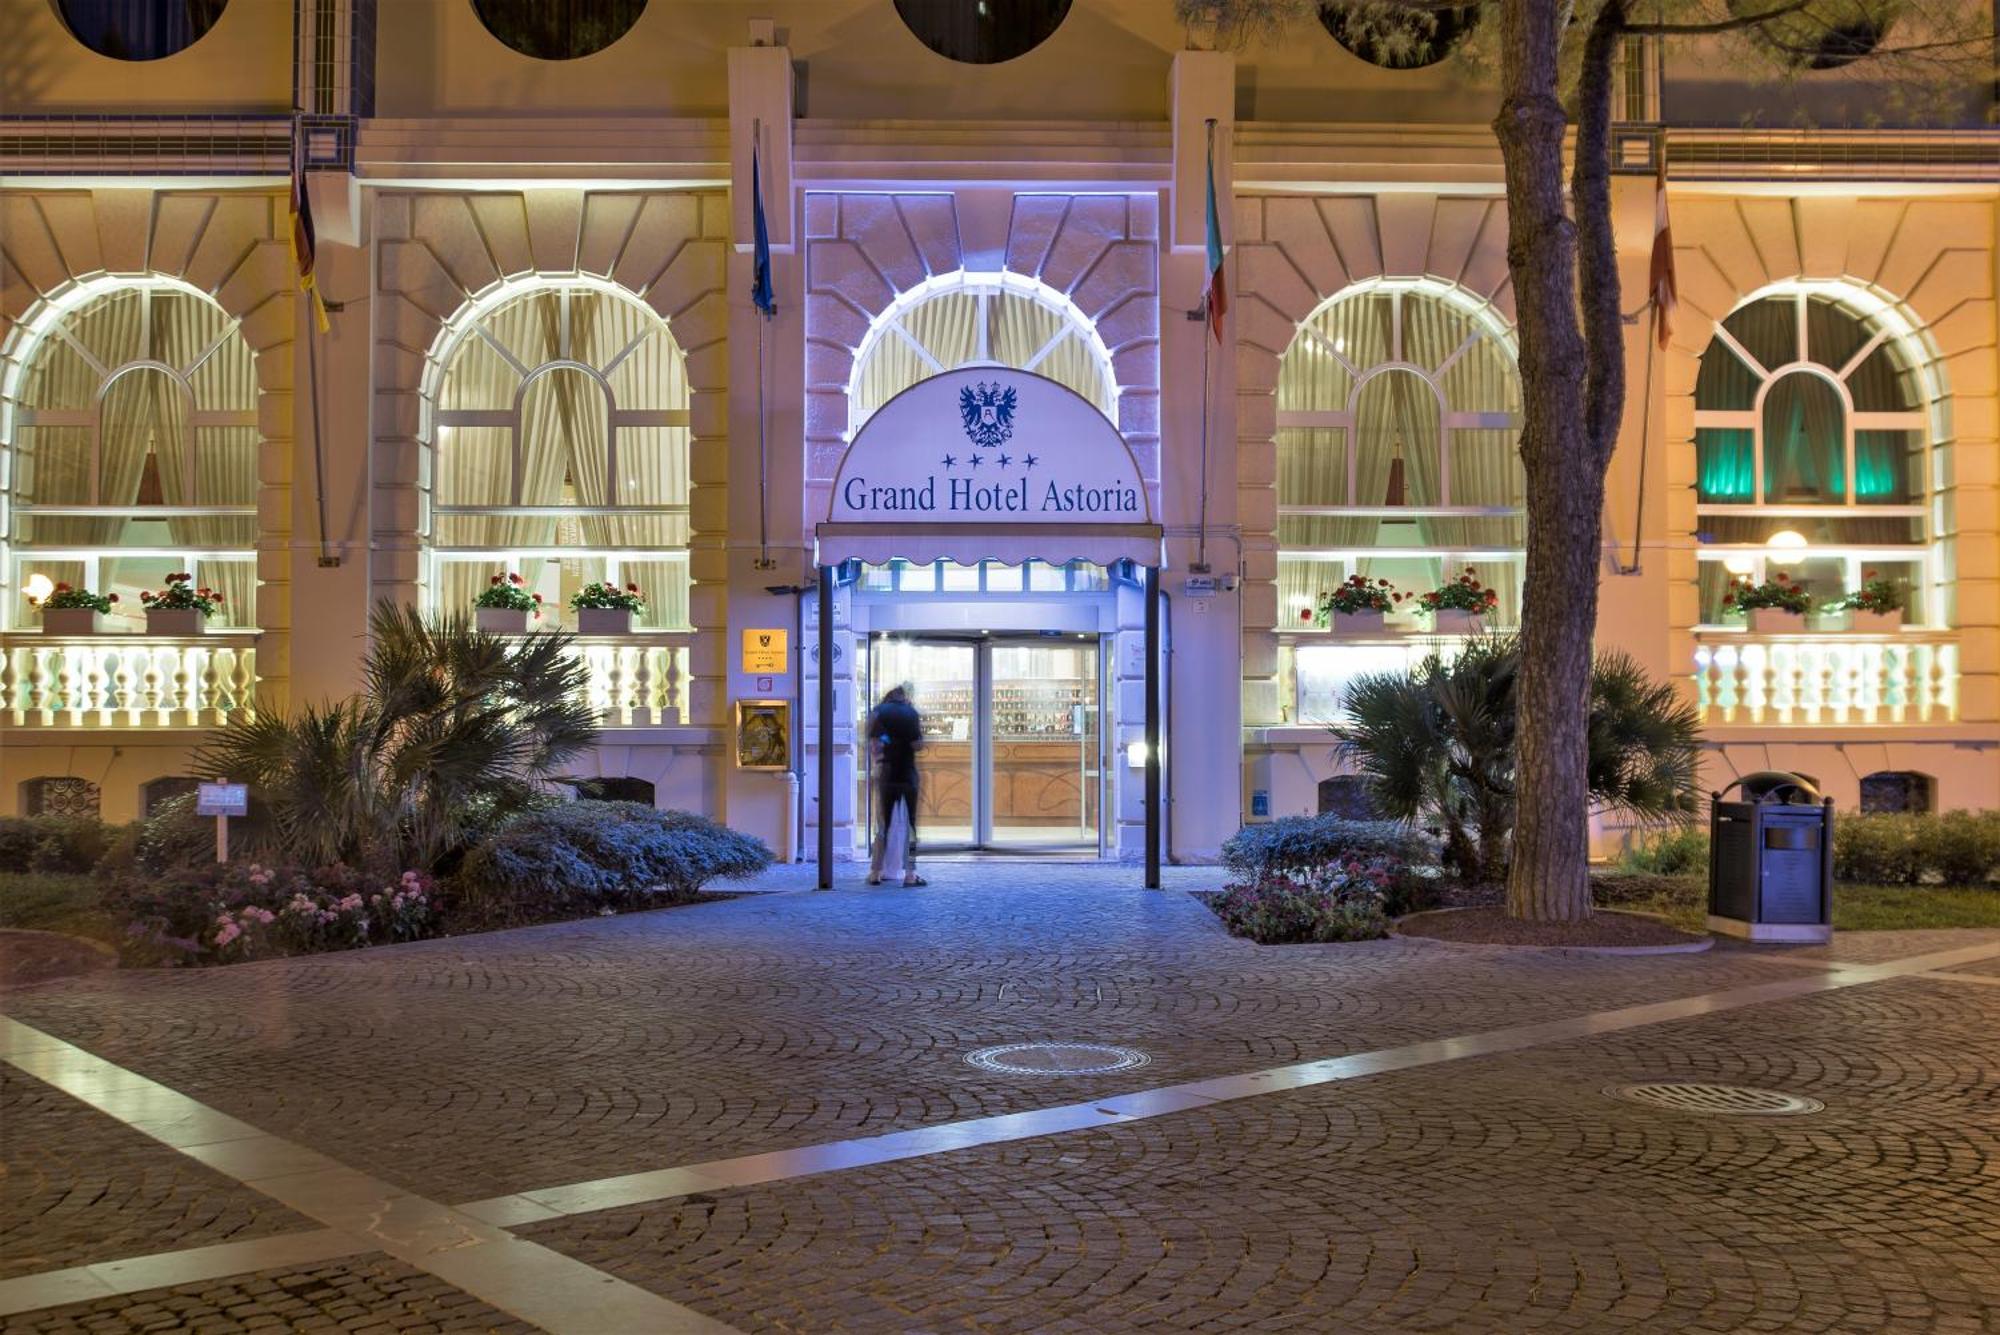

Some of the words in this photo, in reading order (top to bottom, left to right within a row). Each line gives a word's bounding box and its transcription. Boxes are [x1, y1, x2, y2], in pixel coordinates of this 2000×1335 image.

[844, 476, 935, 511] Grand
[948, 477, 1028, 511] Hotel
[1041, 479, 1138, 512] Astoria
